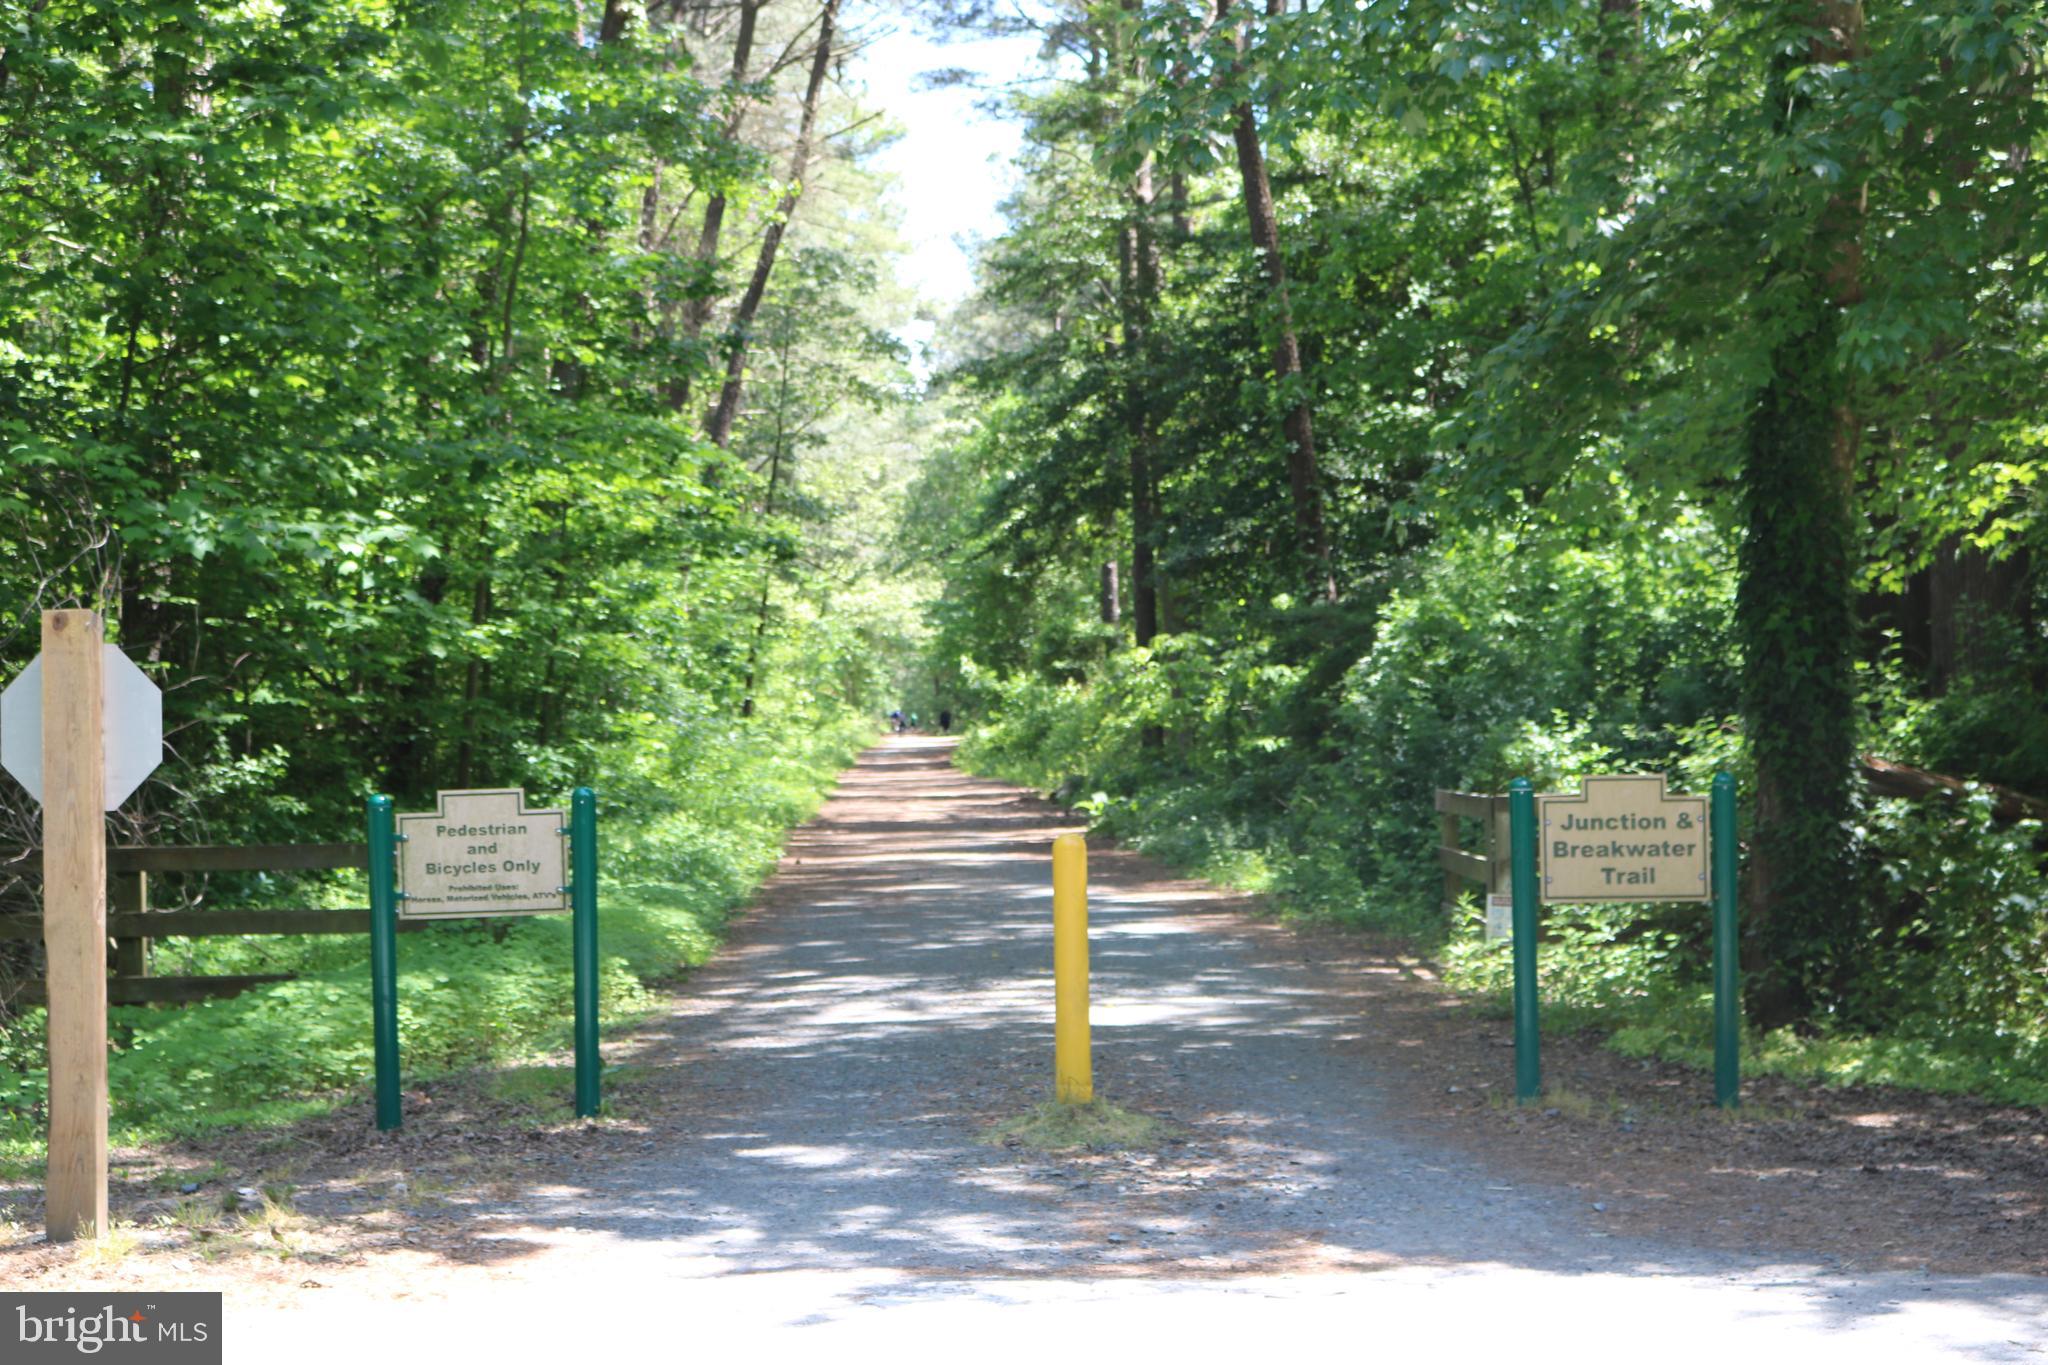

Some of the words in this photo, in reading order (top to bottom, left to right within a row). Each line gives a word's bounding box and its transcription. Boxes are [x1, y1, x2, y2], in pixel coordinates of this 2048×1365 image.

[436, 823, 528, 837] Pedestrian
[1560, 813, 1667, 831] Junction
[1676, 812, 1694, 829] &
[467, 842, 498, 855] and
[1553, 841, 1696, 858] Breakwater
[425, 862, 497, 877] Bicycles
[503, 859, 541, 875] Only
[1601, 867, 1656, 884] Trail
